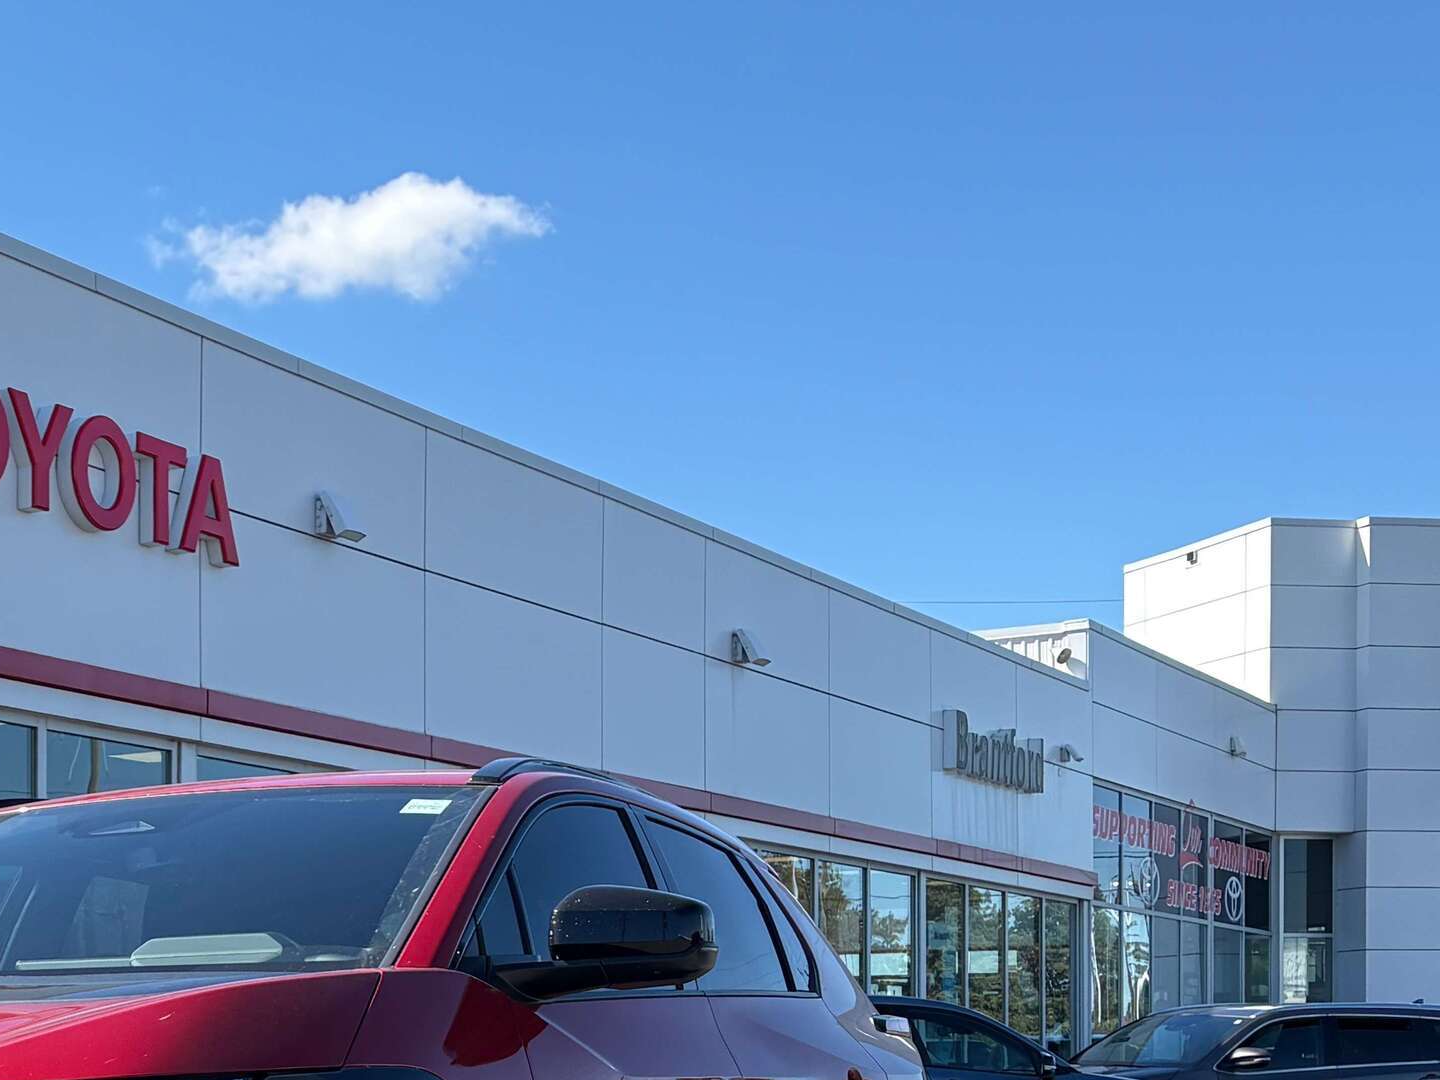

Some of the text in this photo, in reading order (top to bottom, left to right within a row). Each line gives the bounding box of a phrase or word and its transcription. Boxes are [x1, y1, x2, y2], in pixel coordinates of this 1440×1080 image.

[944, 709, 1044, 794] Brantford
[1093, 804, 1177, 858] SUPPORTING
[1166, 879, 1199, 911] SINCE
